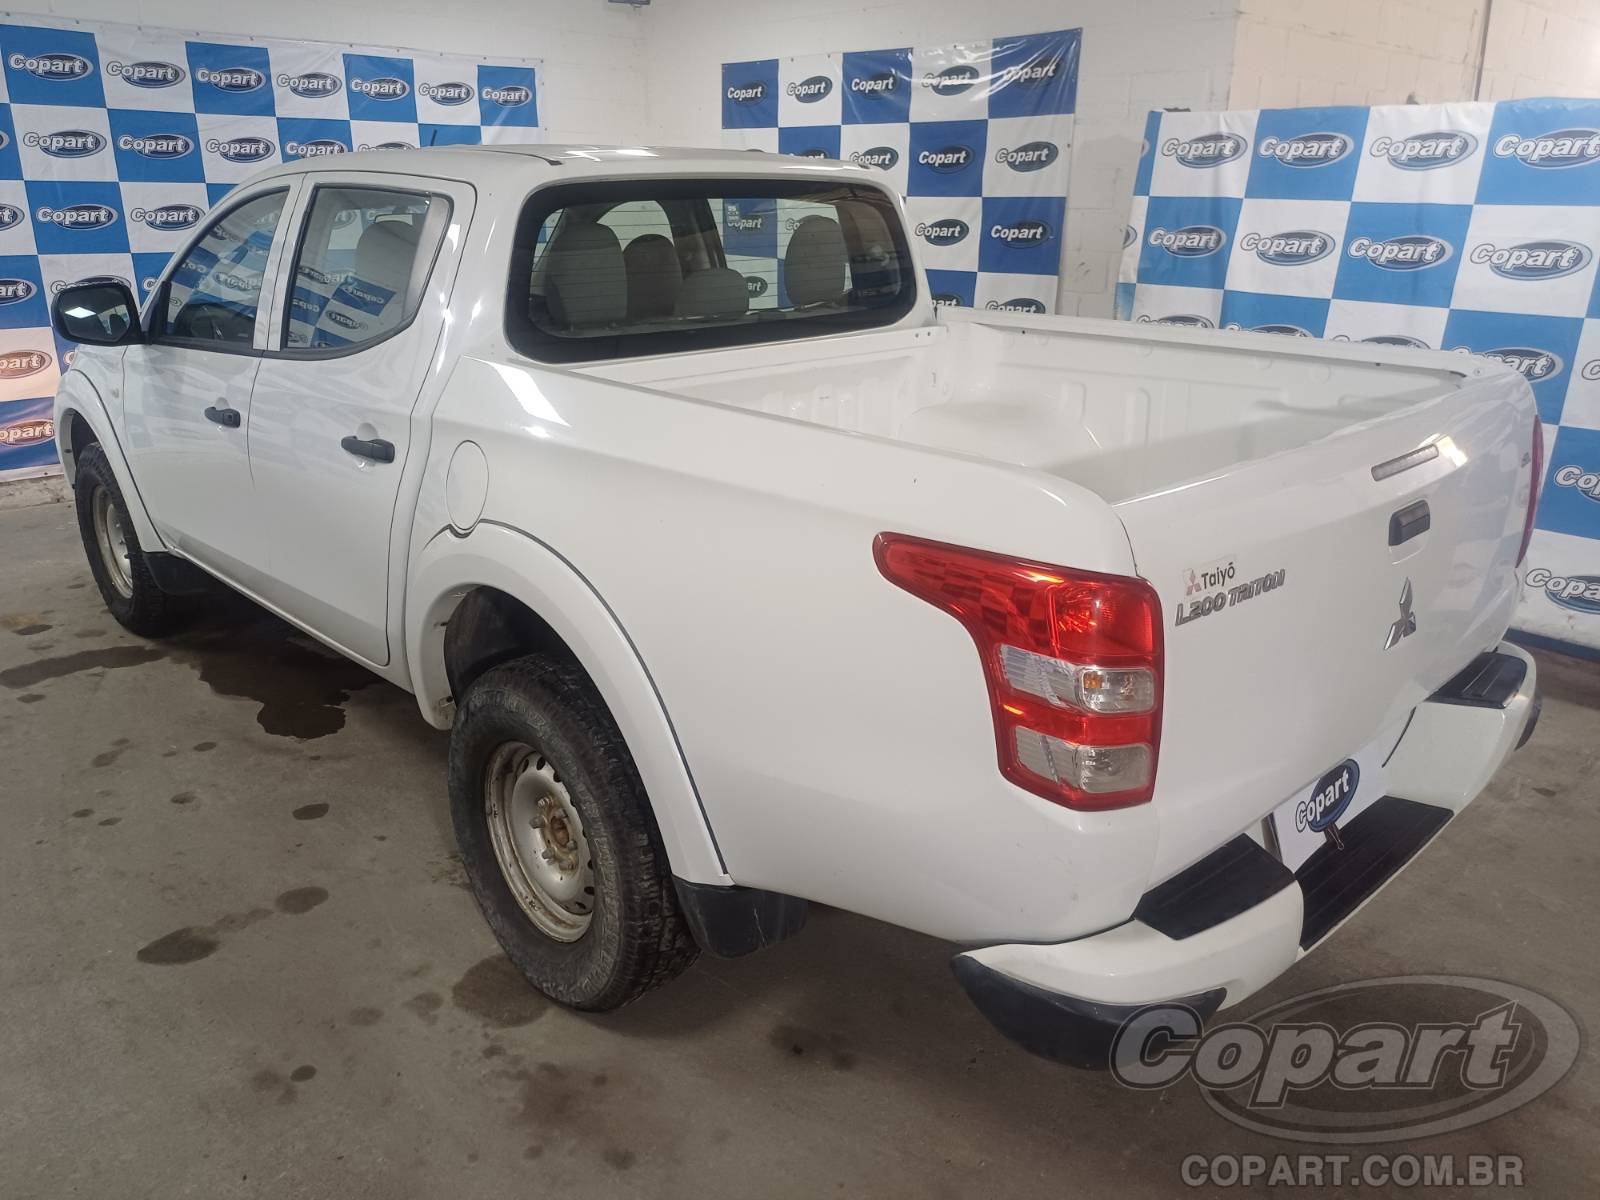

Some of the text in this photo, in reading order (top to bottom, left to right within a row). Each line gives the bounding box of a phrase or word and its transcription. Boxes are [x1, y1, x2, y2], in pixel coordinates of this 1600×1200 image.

[10, 54, 84, 75] Copart
[107, 61, 176, 82] Copart
[197, 68, 258, 86] Copart
[277, 74, 333, 92] Copart
[851, 74, 894, 93] Copart
[351, 79, 402, 96] Copart
[419, 83, 467, 100] Copart
[482, 87, 526, 102] Copart
[727, 86, 763, 101] Copart
[787, 81, 826, 97] Copart
[24, 131, 97, 151] Copart
[119, 135, 186, 155] Copart
[206, 138, 266, 157] Copart
[286, 141, 342, 157] Copart
[1162, 138, 1235, 160] Copart
[1260, 138, 1342, 161] Copart
[1370, 136, 1464, 162] Copart
[1494, 134, 1600, 162] Copart
[919, 150, 968, 168] Copart
[995, 148, 1049, 165] Copart
[37, 207, 107, 227] Copart
[131, 207, 198, 226] Copart
[915, 222, 961, 239] Copart
[991, 225, 1043, 241] Copart
[1148, 227, 1218, 250] Copart
[1241, 233, 1325, 255] Copart
[1349, 237, 1441, 264] Copart
[1470, 243, 1578, 270] Copart
[0, 352, 42, 375] part
[0, 421, 54, 445] opart
[1525, 568, 1600, 599] Copa
[1175, 592, 1226, 626] L200
[1296, 769, 1349, 833] Copart
